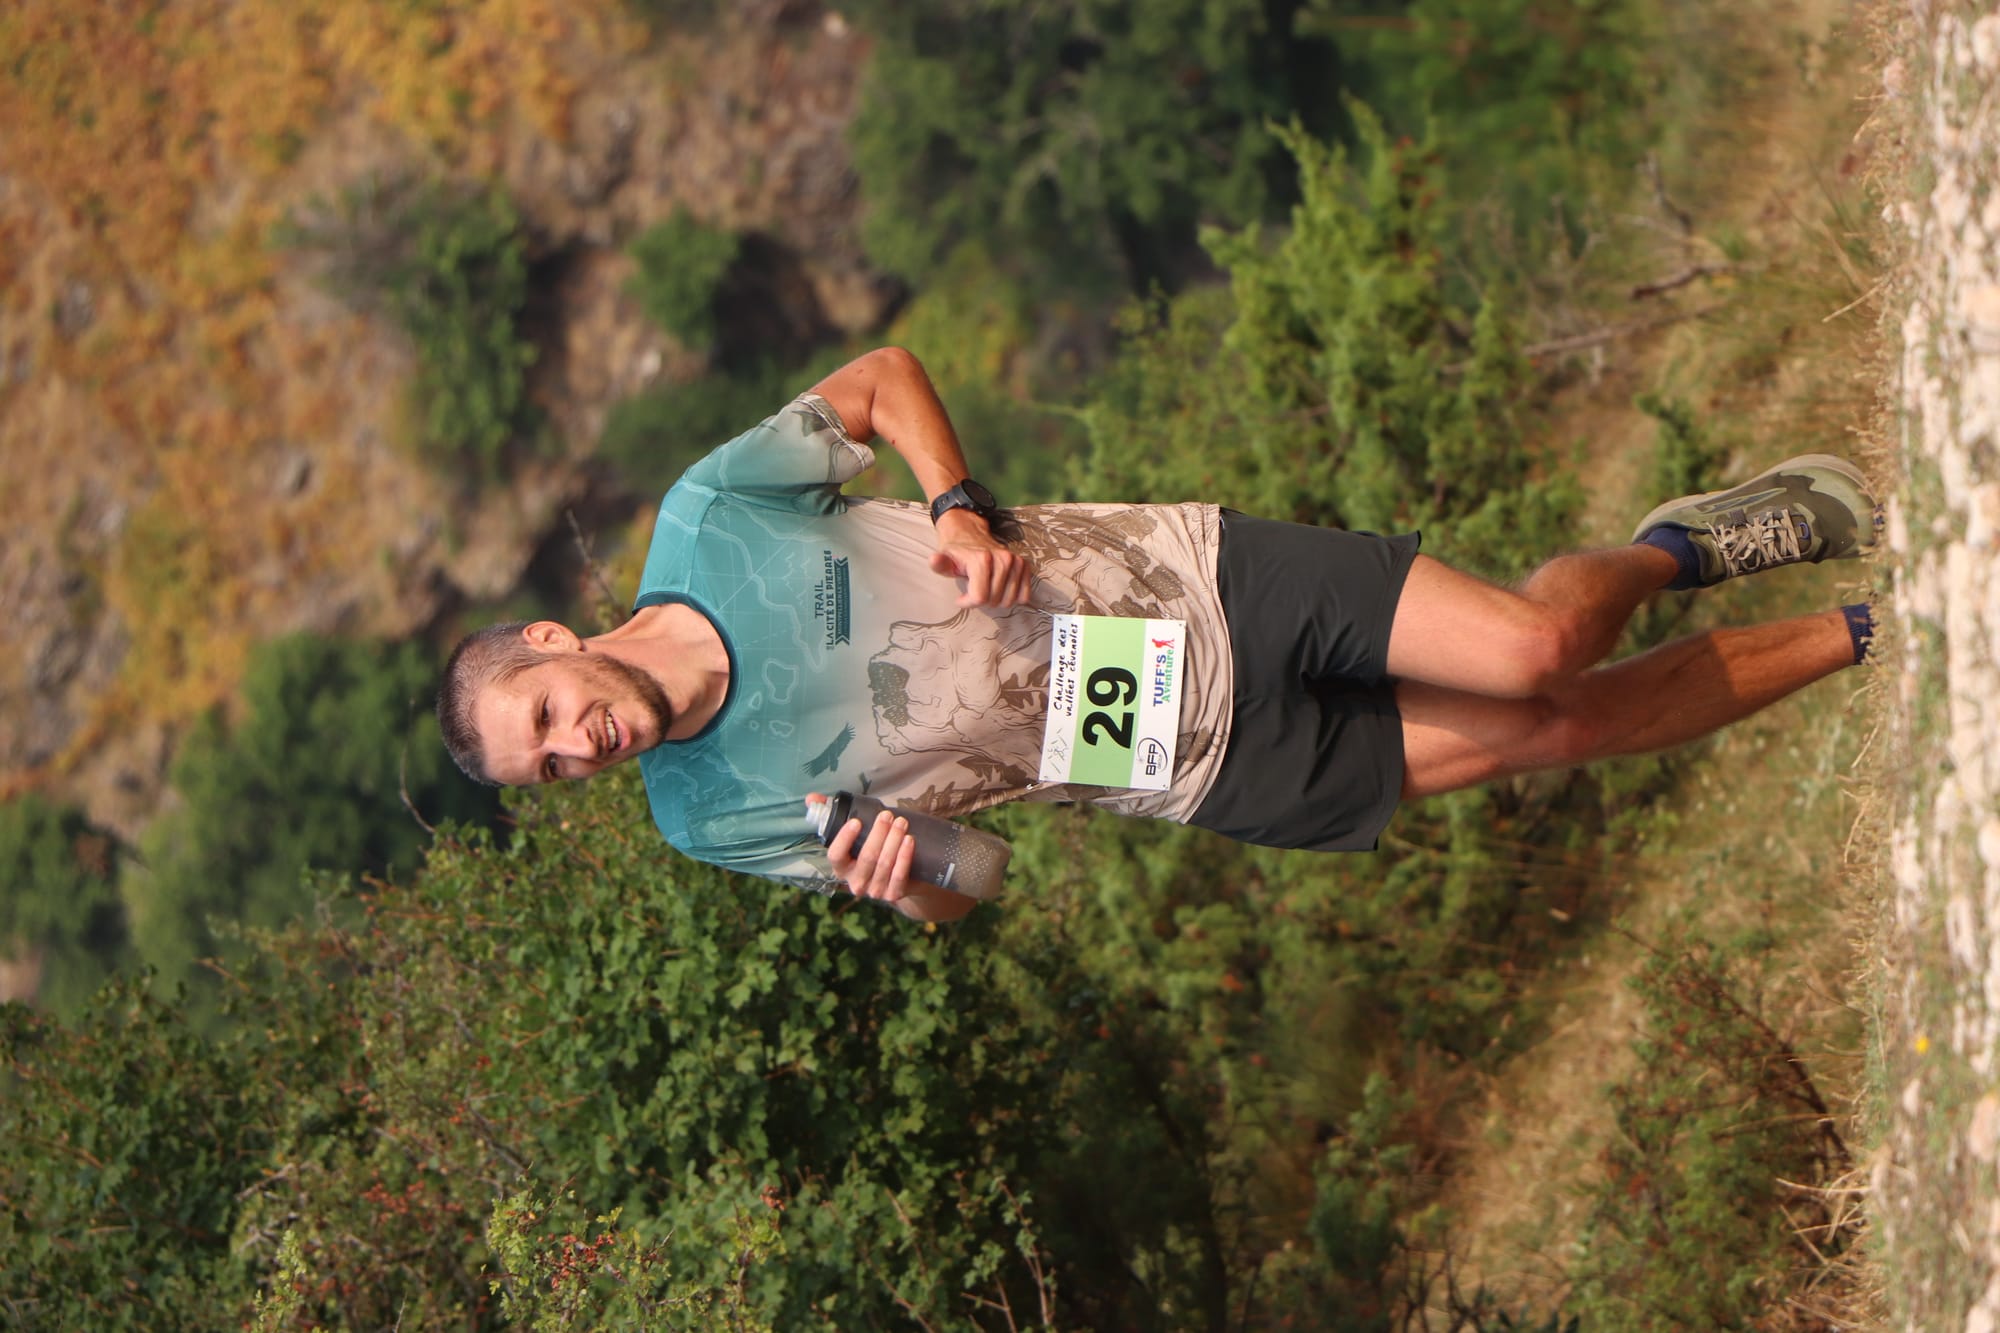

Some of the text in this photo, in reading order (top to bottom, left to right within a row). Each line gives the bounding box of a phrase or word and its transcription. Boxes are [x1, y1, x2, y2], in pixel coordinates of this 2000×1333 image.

[814, 579, 823, 618] TRAIL
[824, 609, 834, 631] CITÉ
[826, 593, 834, 606] DE
[826, 632, 834, 645] LA
[1053, 628, 1068, 711] Challenge des
[1065, 623, 1078, 717] vallées cévenoles
[1152, 654, 1167, 707] TUFF'S
[1164, 649, 1174, 704] Aventure
[1082, 667, 1137, 749] 29
[1145, 743, 1159, 776] BFP
